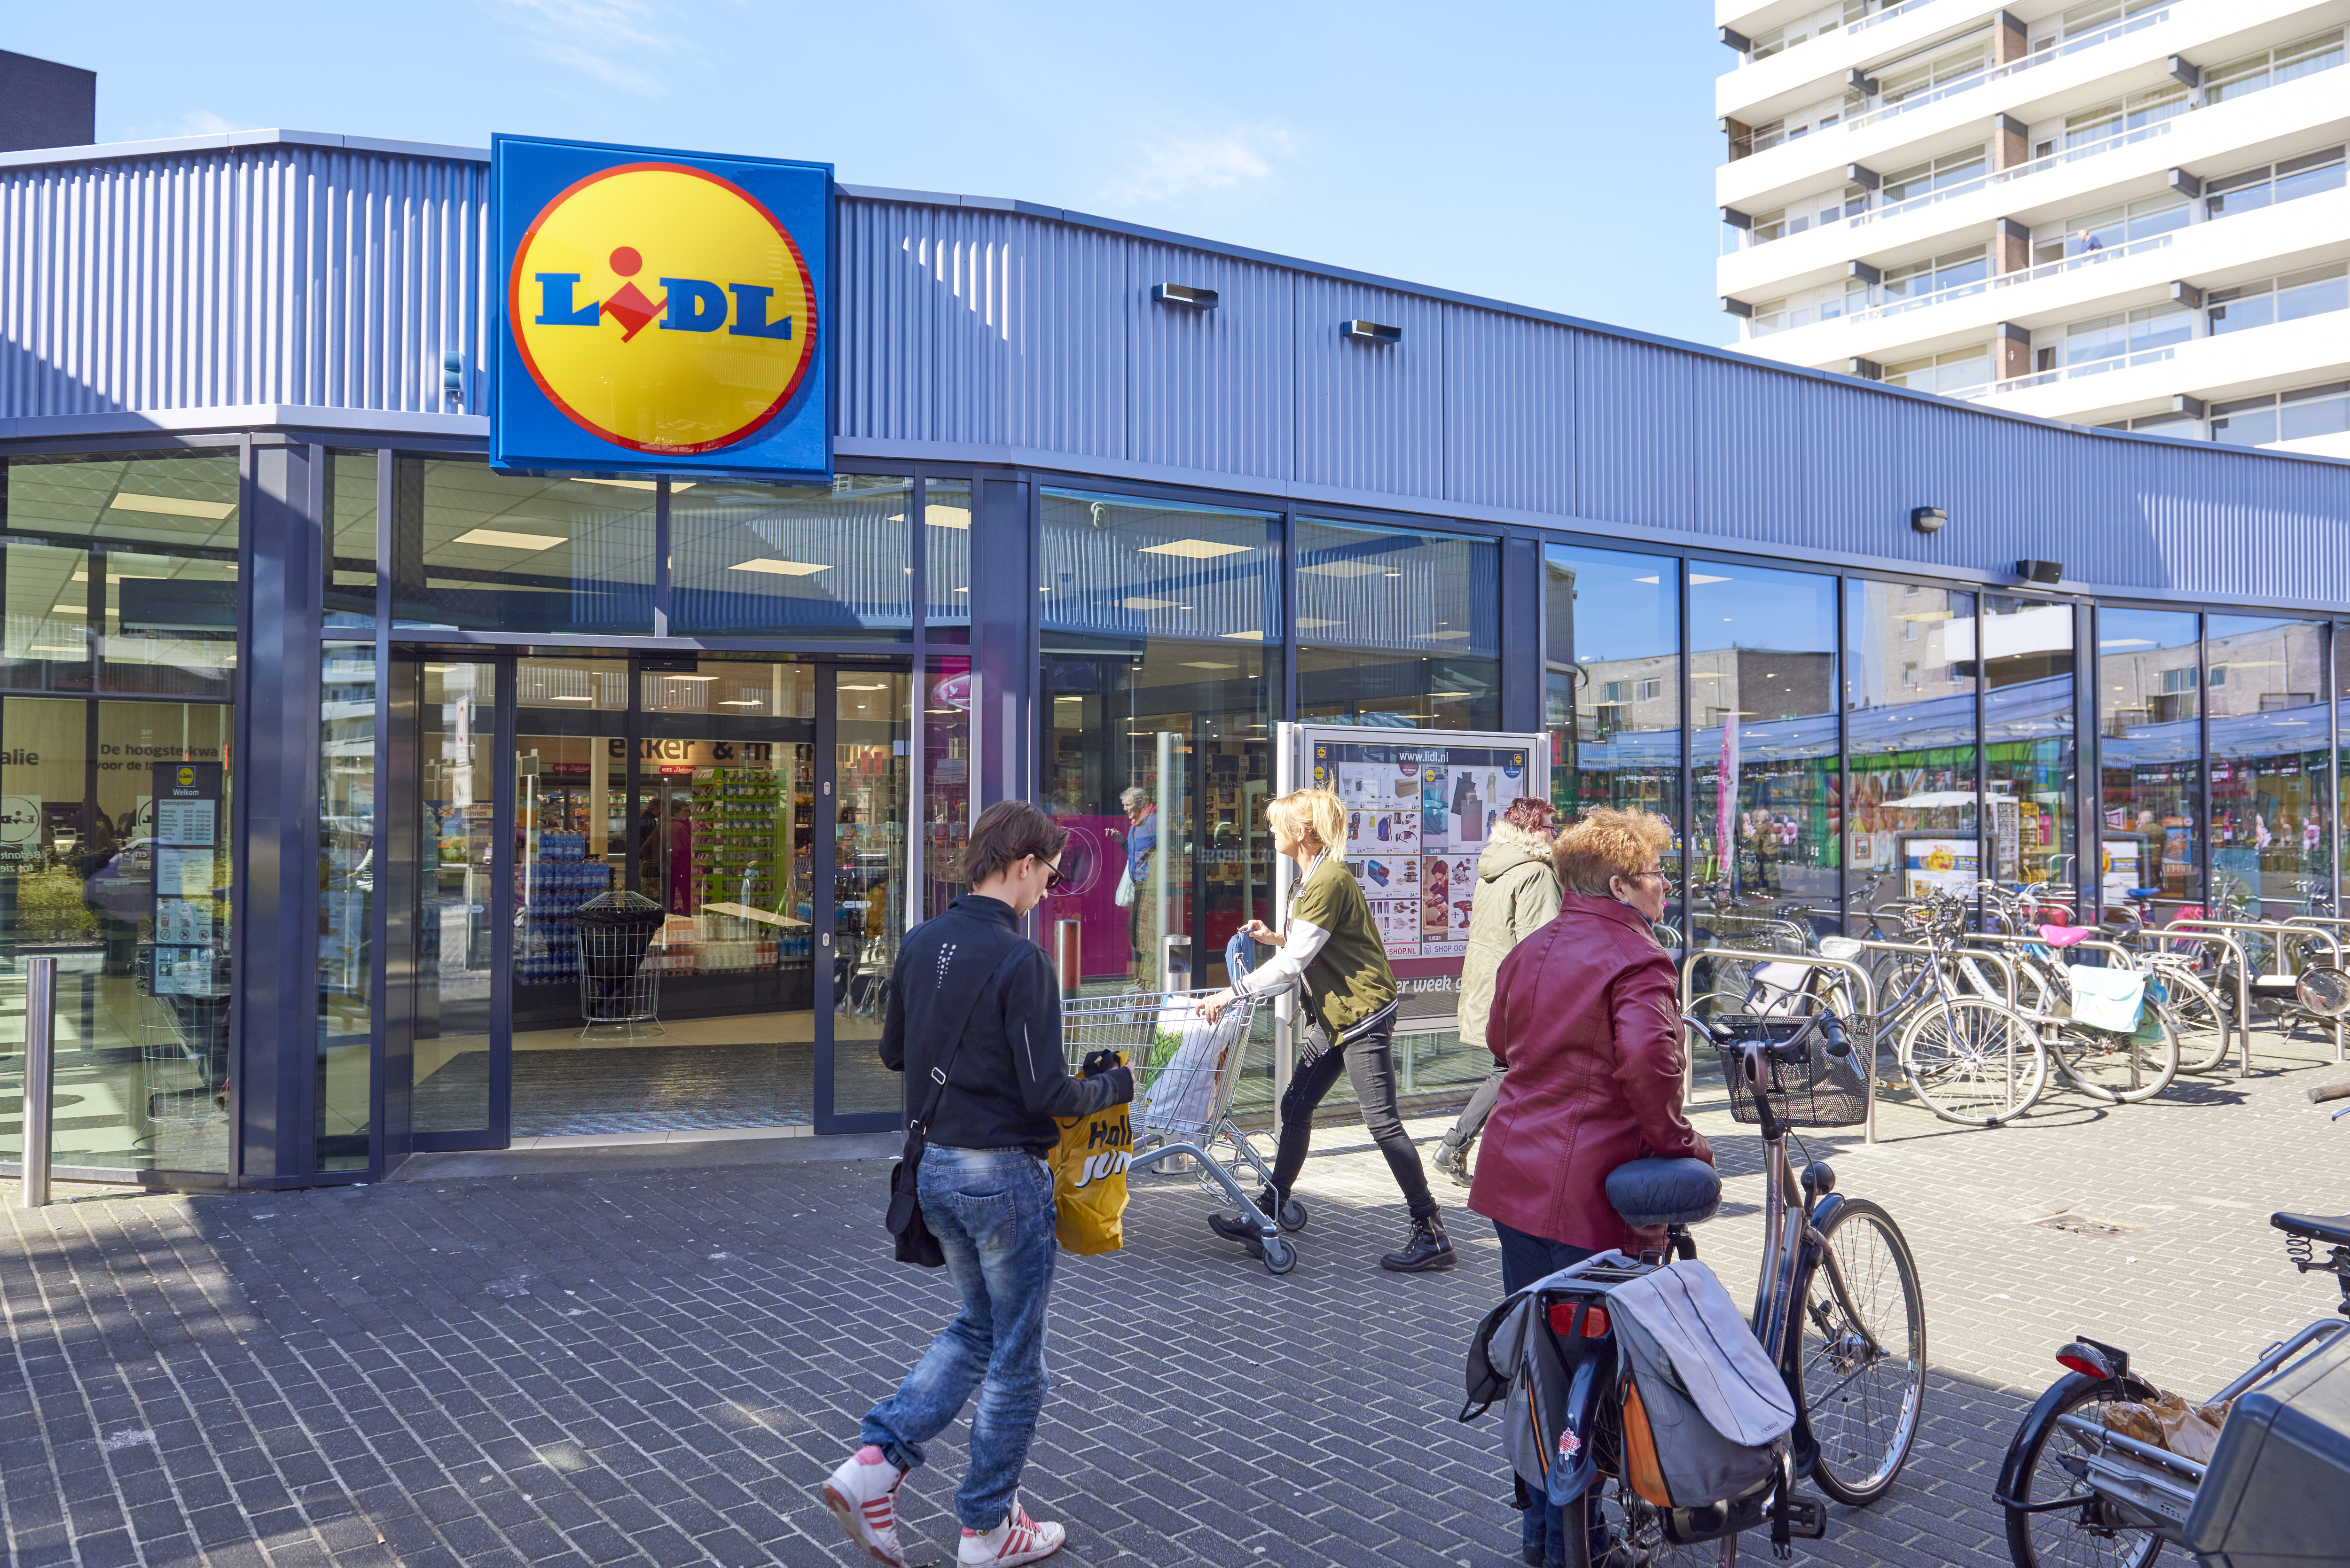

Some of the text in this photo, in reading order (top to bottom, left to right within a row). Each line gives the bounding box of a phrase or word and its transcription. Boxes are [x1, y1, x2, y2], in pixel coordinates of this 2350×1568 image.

[535, 246, 791, 343] LIDL
[101, 744, 120, 755] De
[125, 744, 183, 757] hoogste
[1399, 751, 1449, 762] www.lidl.nl
[1413, 975, 1451, 993] week
